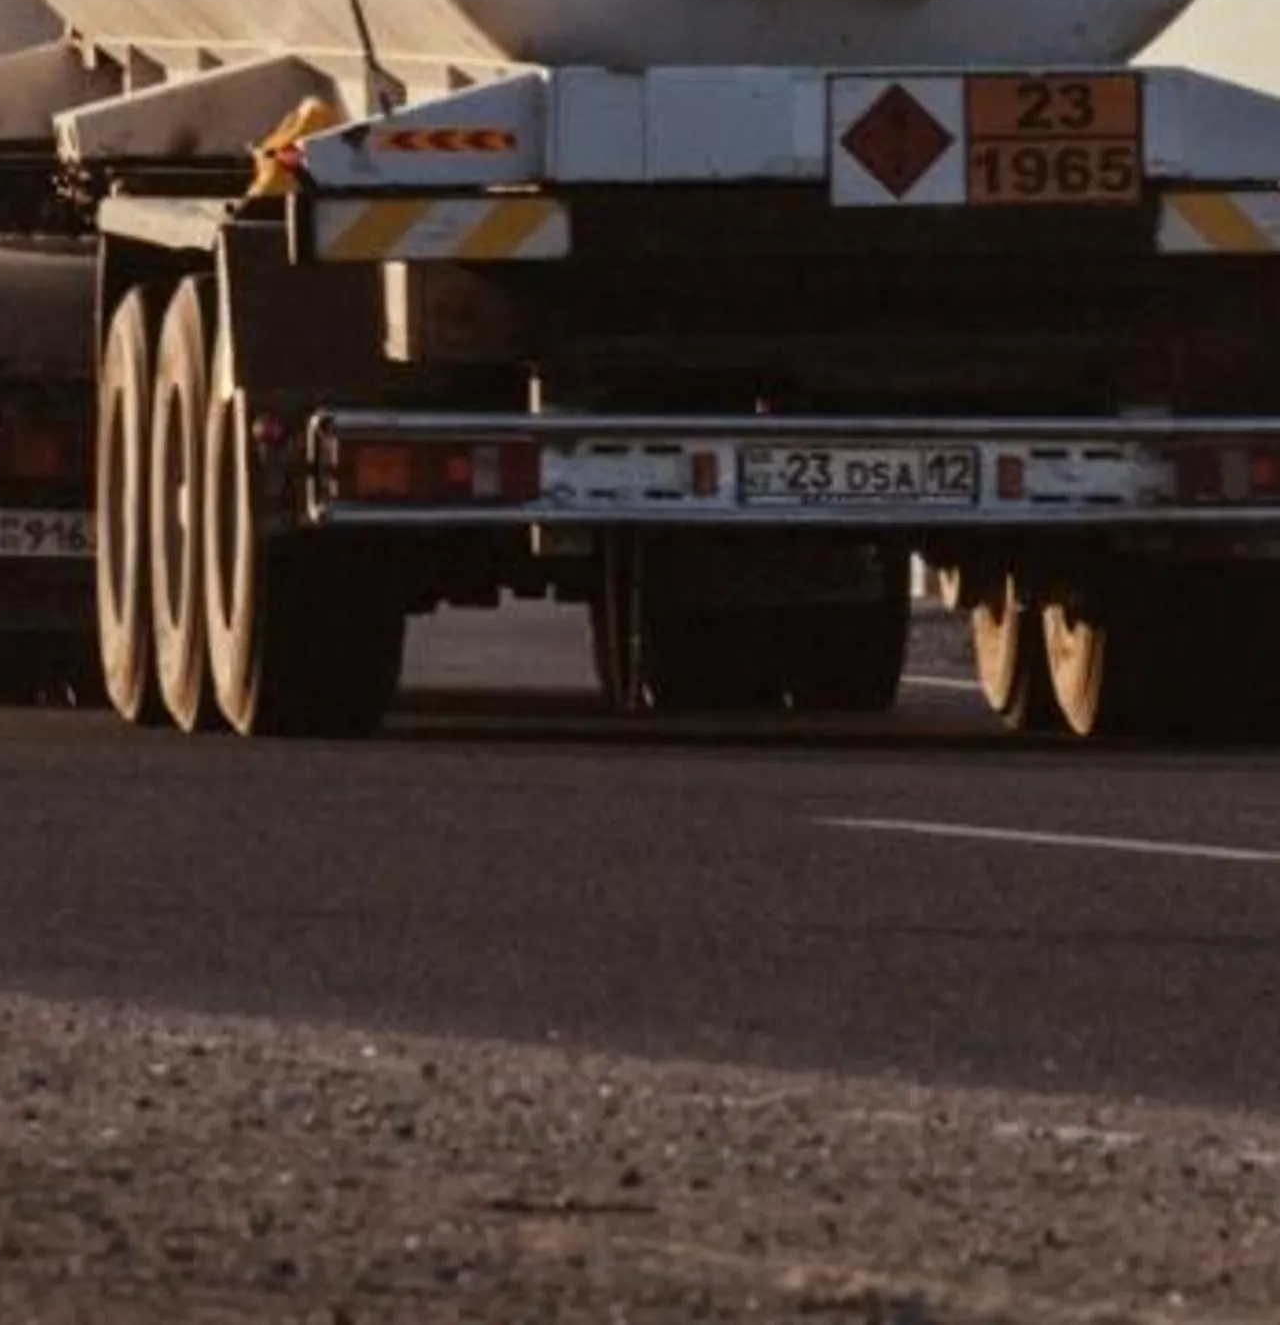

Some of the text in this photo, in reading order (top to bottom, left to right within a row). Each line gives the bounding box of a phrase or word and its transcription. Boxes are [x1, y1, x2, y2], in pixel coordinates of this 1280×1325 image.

[1017, 83, 1096, 130] 23
[977, 146, 1133, 195] 1965
[786, 451, 832, 490] 23
[844, 460, 916, 491] DSA
[928, 453, 970, 490] 12
